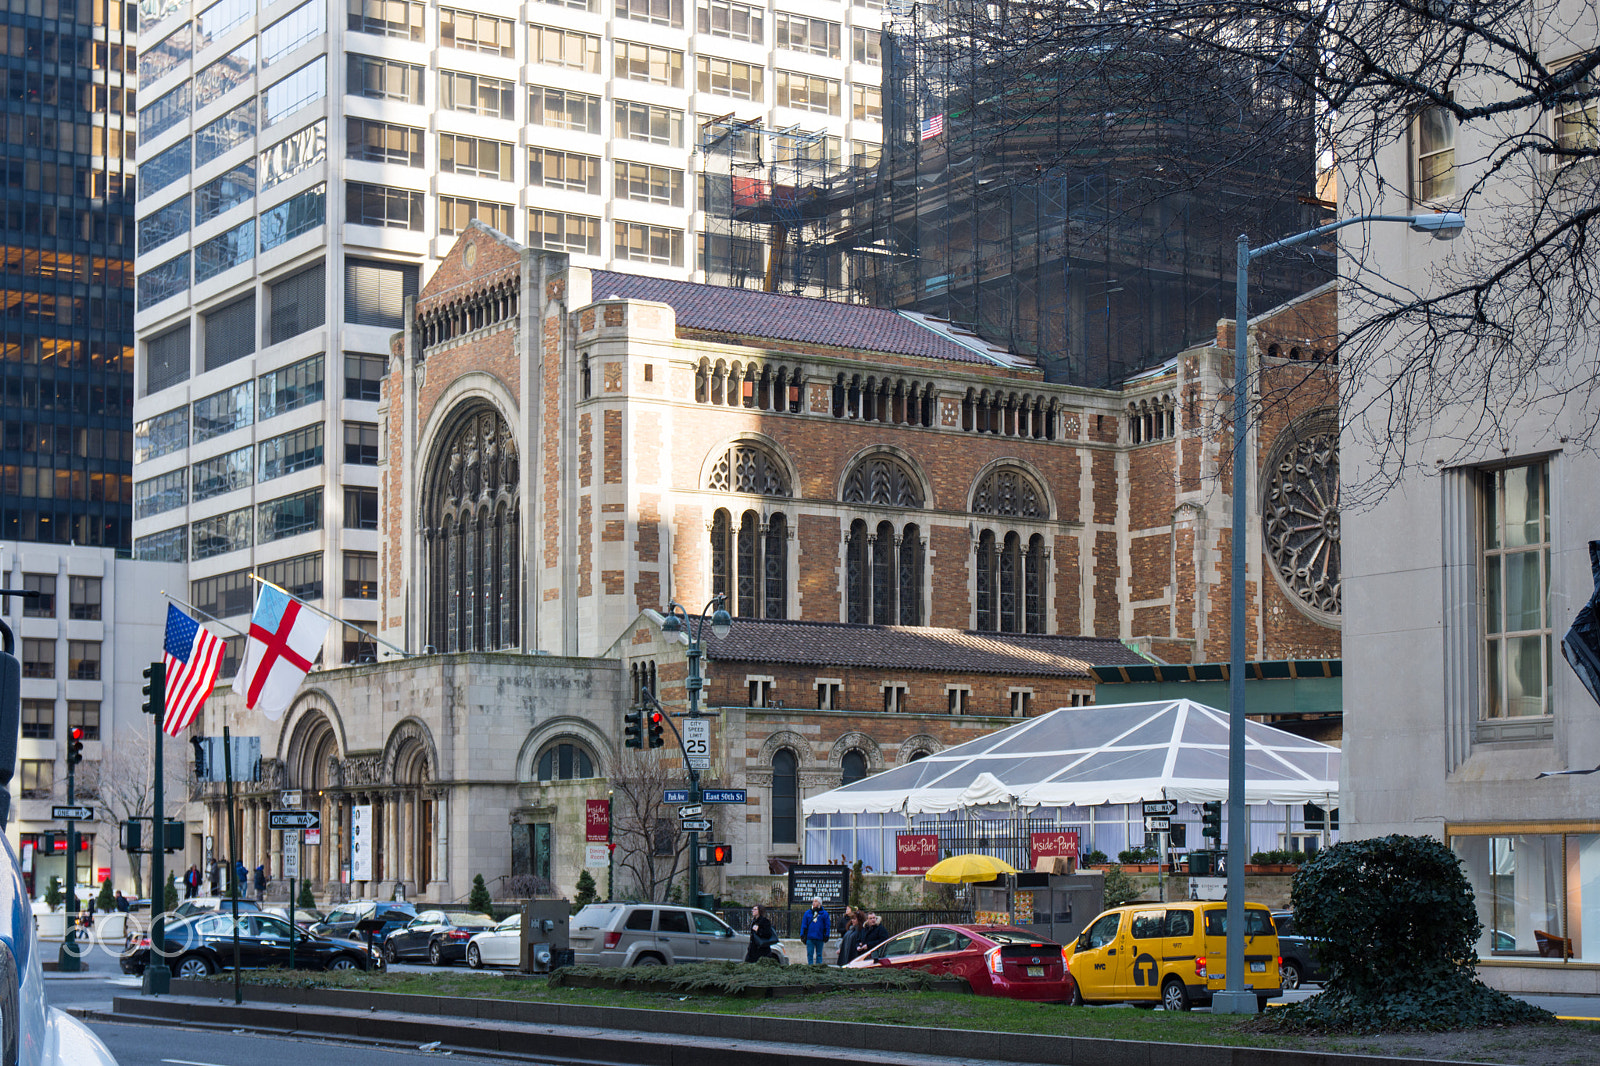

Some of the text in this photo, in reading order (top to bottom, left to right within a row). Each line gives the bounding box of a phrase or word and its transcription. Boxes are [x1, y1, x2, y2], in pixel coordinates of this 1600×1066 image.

[687, 740, 706, 753] 25
[667, 793, 685, 801] Park Ave
[705, 792, 743, 800] East 50th St
[587, 803, 605, 814] Inside
[274, 816, 313, 824] ONE WAY
[592, 813, 608, 825] Park
[285, 835, 297, 846] STOP
[1032, 835, 1076, 855] Inside Park
[898, 838, 937, 856] Inside Park
[286, 855, 296, 866] RED
[1138, 962, 1153, 986] T
